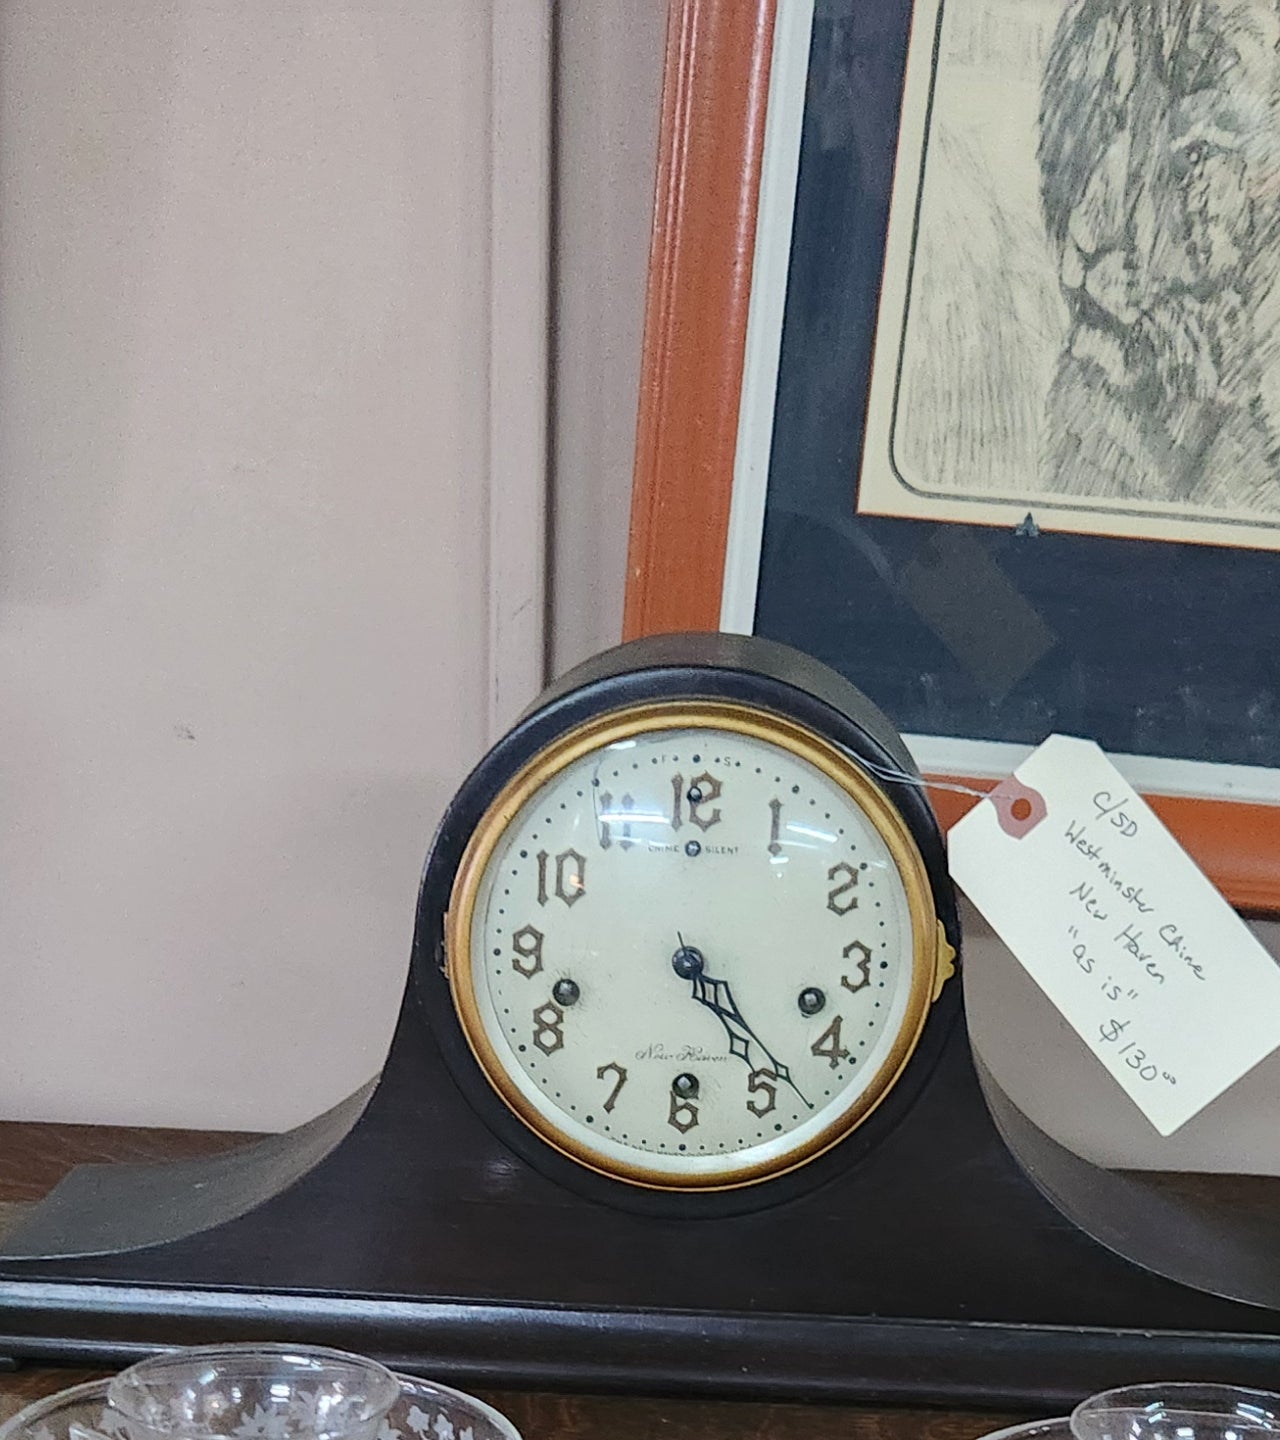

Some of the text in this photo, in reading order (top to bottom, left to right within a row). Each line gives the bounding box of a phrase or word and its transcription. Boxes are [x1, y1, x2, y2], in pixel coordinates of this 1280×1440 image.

[598, 791, 635, 850] 11
[671, 771, 723, 832] 12
[768, 797, 784, 856] 1
[536, 848, 587, 907] 10
[705, 846, 739, 855] SILENT
[826, 861, 860, 916] 2
[511, 925, 544, 979] 9
[840, 940, 872, 993] 3
[532, 1000, 564, 1056] 8
[810, 1015, 849, 1069] 4
[596, 1062, 628, 1113] 7
[668, 1089, 700, 1134] 6
[746, 1067, 778, 1118] 5
